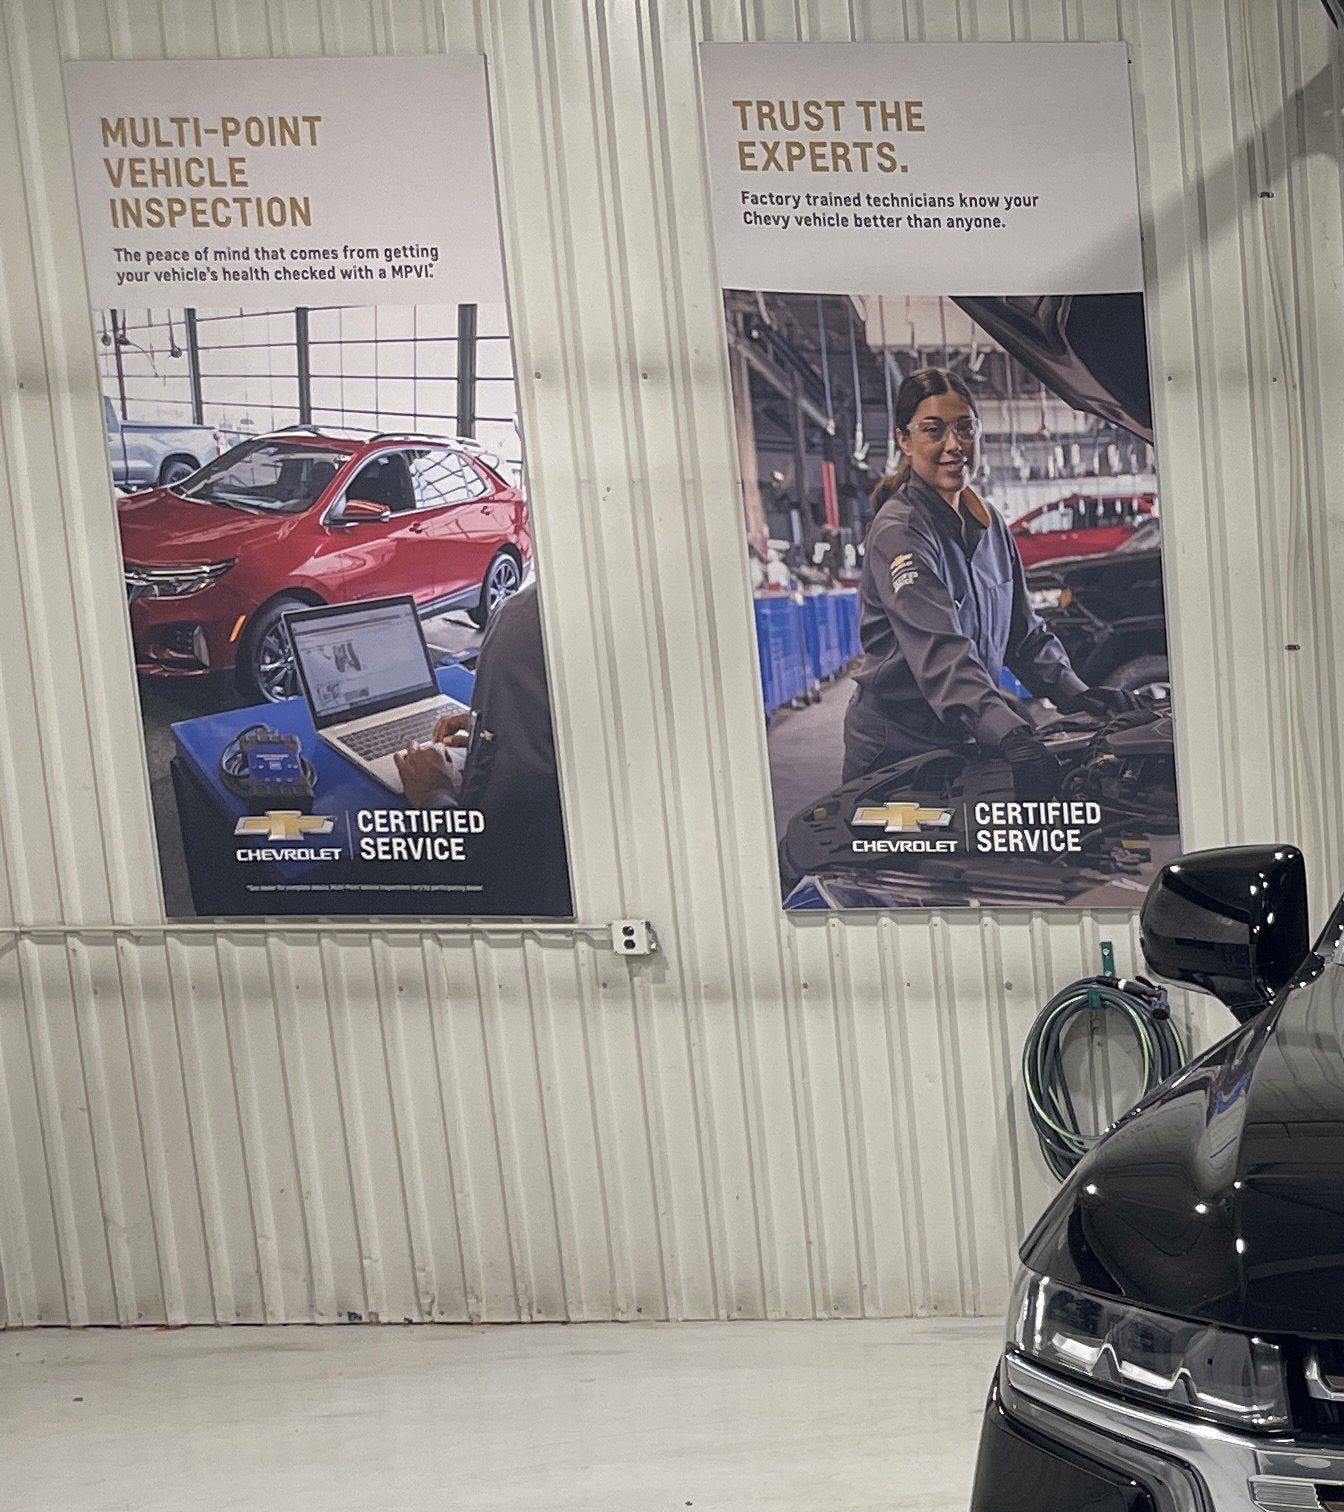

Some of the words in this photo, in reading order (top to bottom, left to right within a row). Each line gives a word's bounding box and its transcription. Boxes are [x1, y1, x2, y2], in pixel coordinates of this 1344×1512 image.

[732, 100, 844, 132] TRUST
[856, 100, 925, 132] THE
[101, 115, 322, 147] MULTI-POINT
[738, 141, 908, 172] EXPERTS.
[104, 157, 249, 189] VEHICLE
[110, 197, 313, 229] INSPECTION
[741, 191, 800, 211] Factory
[805, 192, 862, 209] trained
[865, 192, 955, 209] technicians
[958, 192, 1000, 209] know
[1004, 194, 1039, 212] your
[742, 211, 790, 231] Chevy
[794, 212, 850, 229] vehicle
[854, 212, 903, 229] better
[906, 212, 943, 229] than
[946, 215, 1006, 231] anyone.
[114, 248, 142, 263] The
[145, 248, 189, 267] peace
[193, 247, 210, 263] of
[213, 247, 250, 263] mind
[252, 247, 287, 262] that
[290, 248, 338, 262] comes
[341, 246, 380, 261] from
[384, 245, 439, 265] getting
[116, 269, 150, 285] your
[222, 266, 270, 283] health
[274, 266, 336, 282] checked
[340, 265, 374, 281] with
[378, 269, 387, 281] a
[357, 810, 486, 833] CERTIFIED
[975, 802, 1101, 825] CERTIFIED
[360, 838, 466, 861] SERVICE
[852, 839, 958, 853] CHEVROLET
[976, 830, 1081, 852] SERVICE
[236, 847, 342, 862] CHEVROLET
